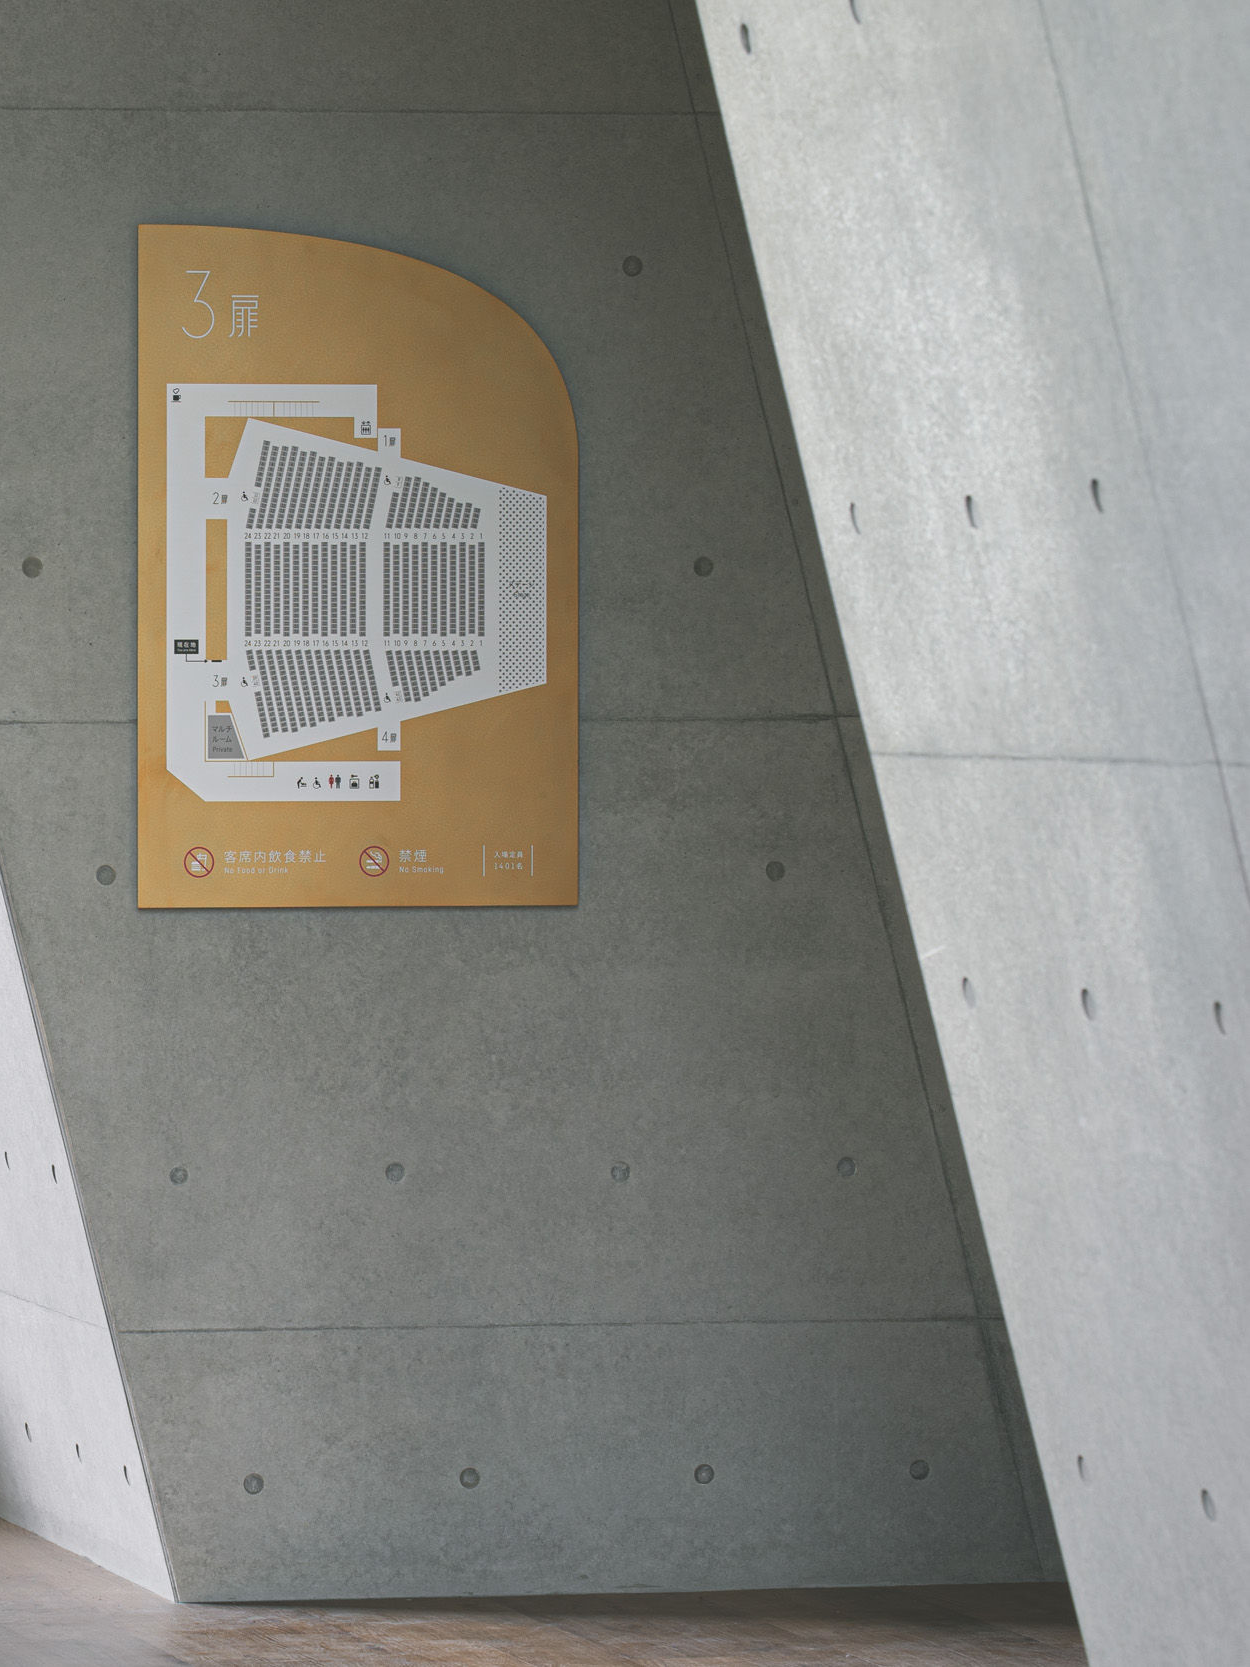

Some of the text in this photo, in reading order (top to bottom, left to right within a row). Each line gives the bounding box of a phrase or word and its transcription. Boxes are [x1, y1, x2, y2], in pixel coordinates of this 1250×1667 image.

[182, 270, 259, 338] 3扉
[244, 639, 251, 647] 24
[254, 639, 261, 647] 23
[264, 639, 271, 647] 22
[273, 639, 279, 647] 21
[283, 639, 290, 647] 20
[294, 639, 300, 647] 19
[303, 639, 309, 647] 18
[313, 639, 319, 647] 17
[323, 639, 329, 647] 16
[332, 639, 338, 647] 15
[342, 639, 348, 647] 14
[352, 639, 358, 647] 13
[362, 639, 368, 647] 12
[383, 639, 390, 647] 11
[393, 639, 401, 647] 10
[224, 849, 326, 864] 客席内飲食禁止
[399, 849, 427, 863] 禁煙
[412, 866, 444, 874] Smoking
